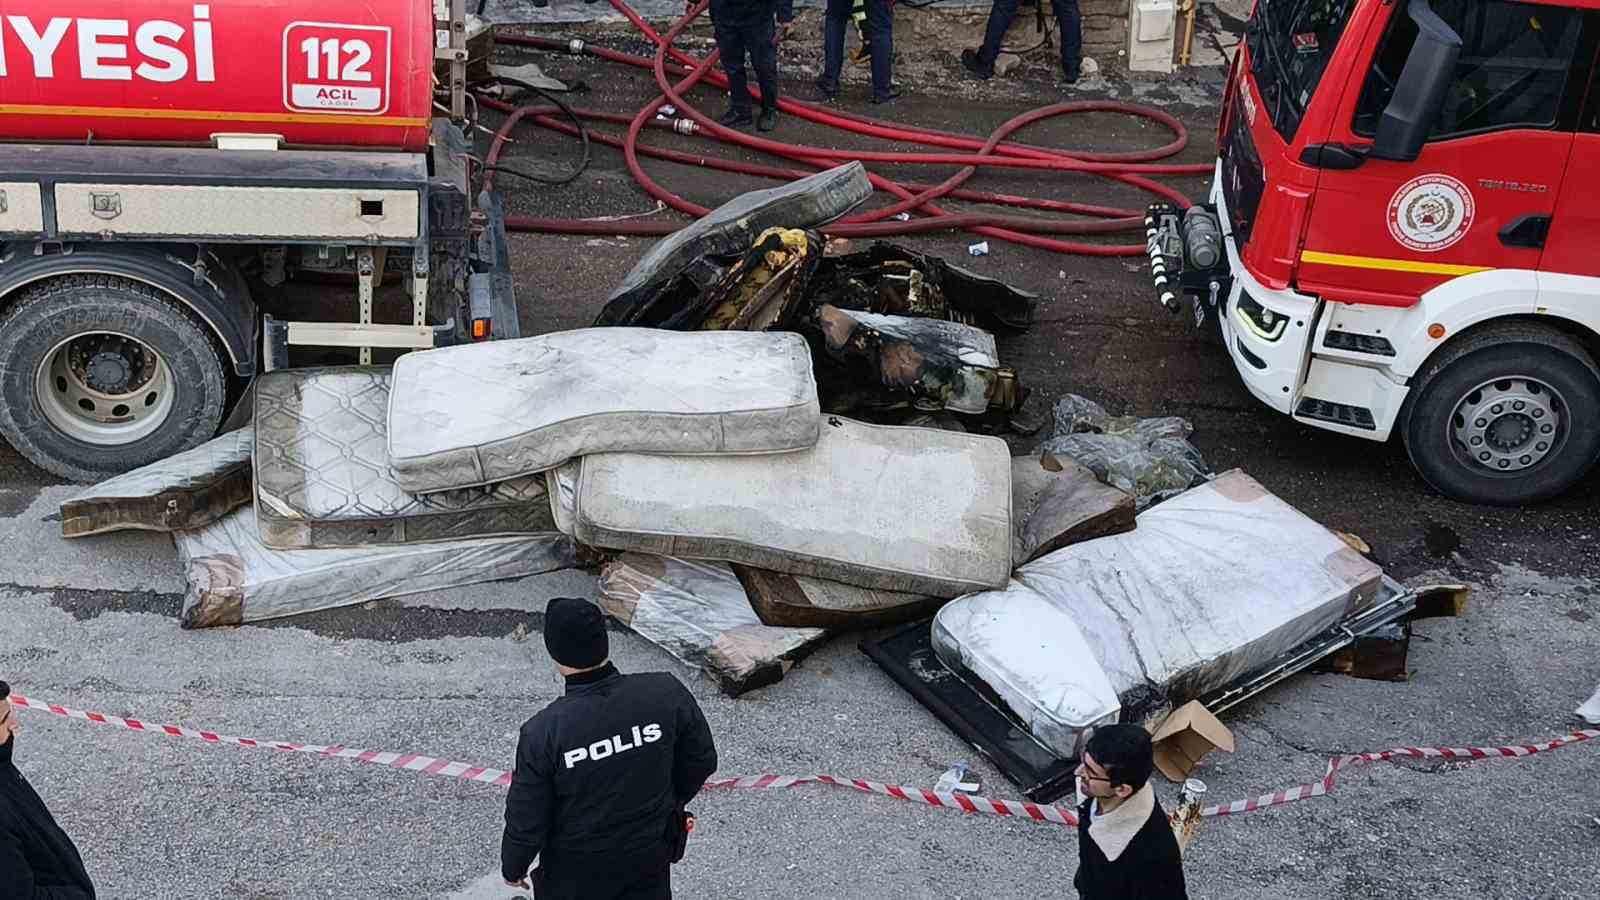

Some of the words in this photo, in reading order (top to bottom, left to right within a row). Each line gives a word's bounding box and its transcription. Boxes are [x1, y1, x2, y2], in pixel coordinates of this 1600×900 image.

[0, 4, 215, 82] YESİ
[301, 37, 371, 81] 112
[316, 88, 358, 100] ACİL
[564, 723, 662, 769] POLİS
